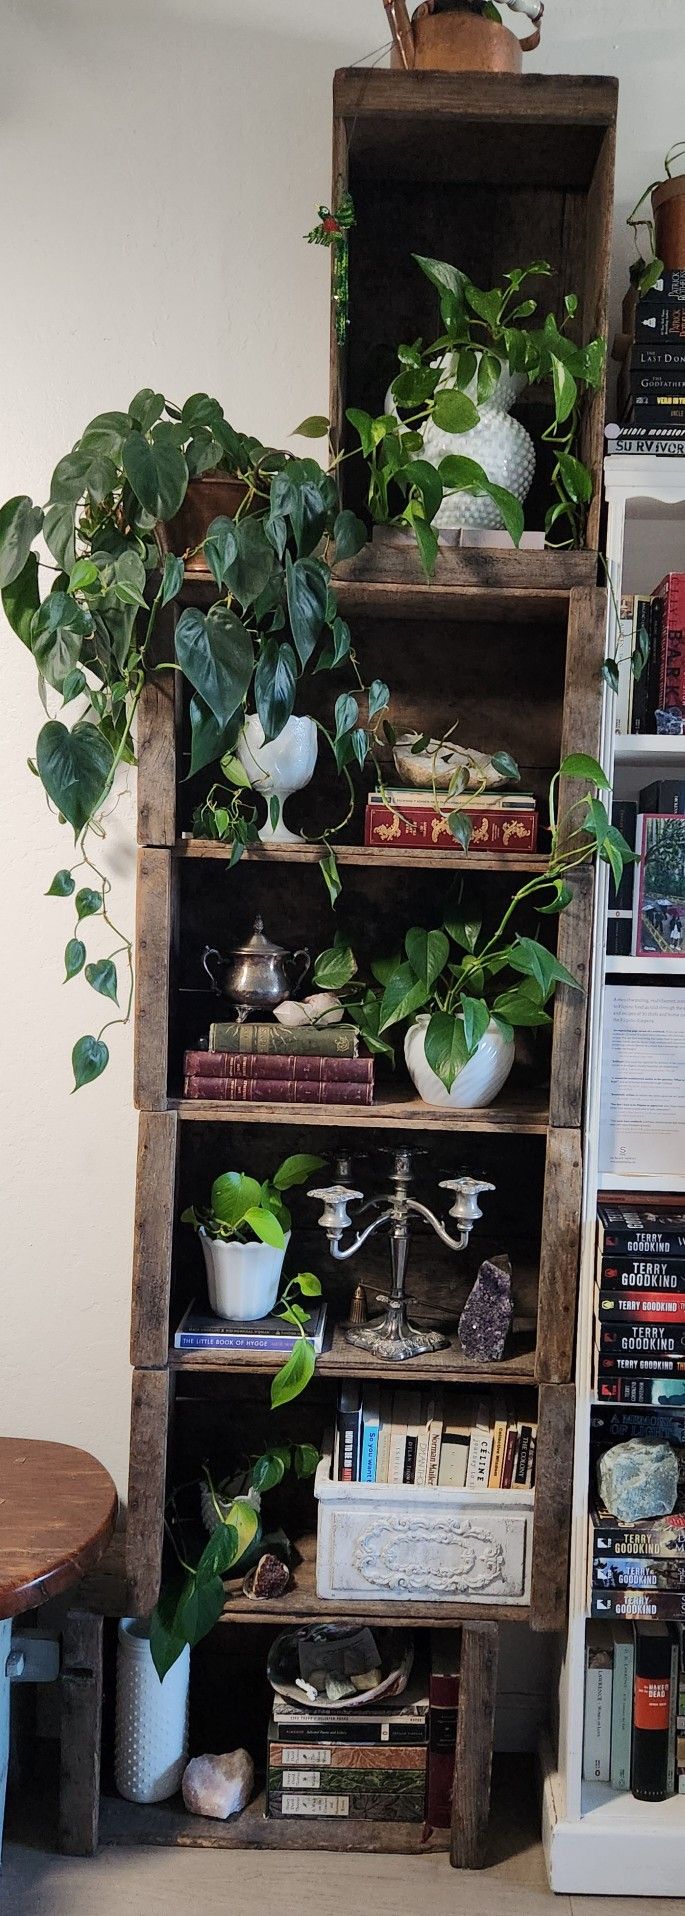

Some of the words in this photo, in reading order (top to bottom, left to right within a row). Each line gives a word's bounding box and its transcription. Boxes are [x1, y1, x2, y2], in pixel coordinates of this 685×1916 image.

[668, 272, 680, 297] PATRICK
[641, 354, 662, 363] LAST
[664, 354, 685, 363] DON
[666, 630, 683, 707] BARK
[636, 1234, 662, 1242] TERRY
[627, 1242, 670, 1253] GOODKIND
[633, 1262, 668, 1274] TERRY
[621, 1274, 677, 1288] GOODKIND
[618, 1300, 640, 1310] TERRY
[642, 1301, 677, 1312] GOODKIND
[632, 1327, 665, 1338] TERRY
[621, 1338, 674, 1350] GOODKIND
[617, 1360, 638, 1369] TERRY
[640, 1360, 673, 1370] GOODKIND
[345, 1430, 353, 1444] HOW
[369, 1432, 375, 1442] So
[430, 1434, 440, 1462] Norman
[478, 1441, 491, 1482] CÉLINE
[518, 1452, 526, 1478] COLONY
[342, 1468, 352, 1481] ANTI
[624, 1534, 652, 1544] TERRY
[615, 1543, 660, 1554] GOODKIND
[626, 1567, 649, 1576] TERRY
[618, 1575, 657, 1584] GOODKIND
[624, 1596, 649, 1604] TERRY
[616, 1605, 657, 1614] GOODKIND
